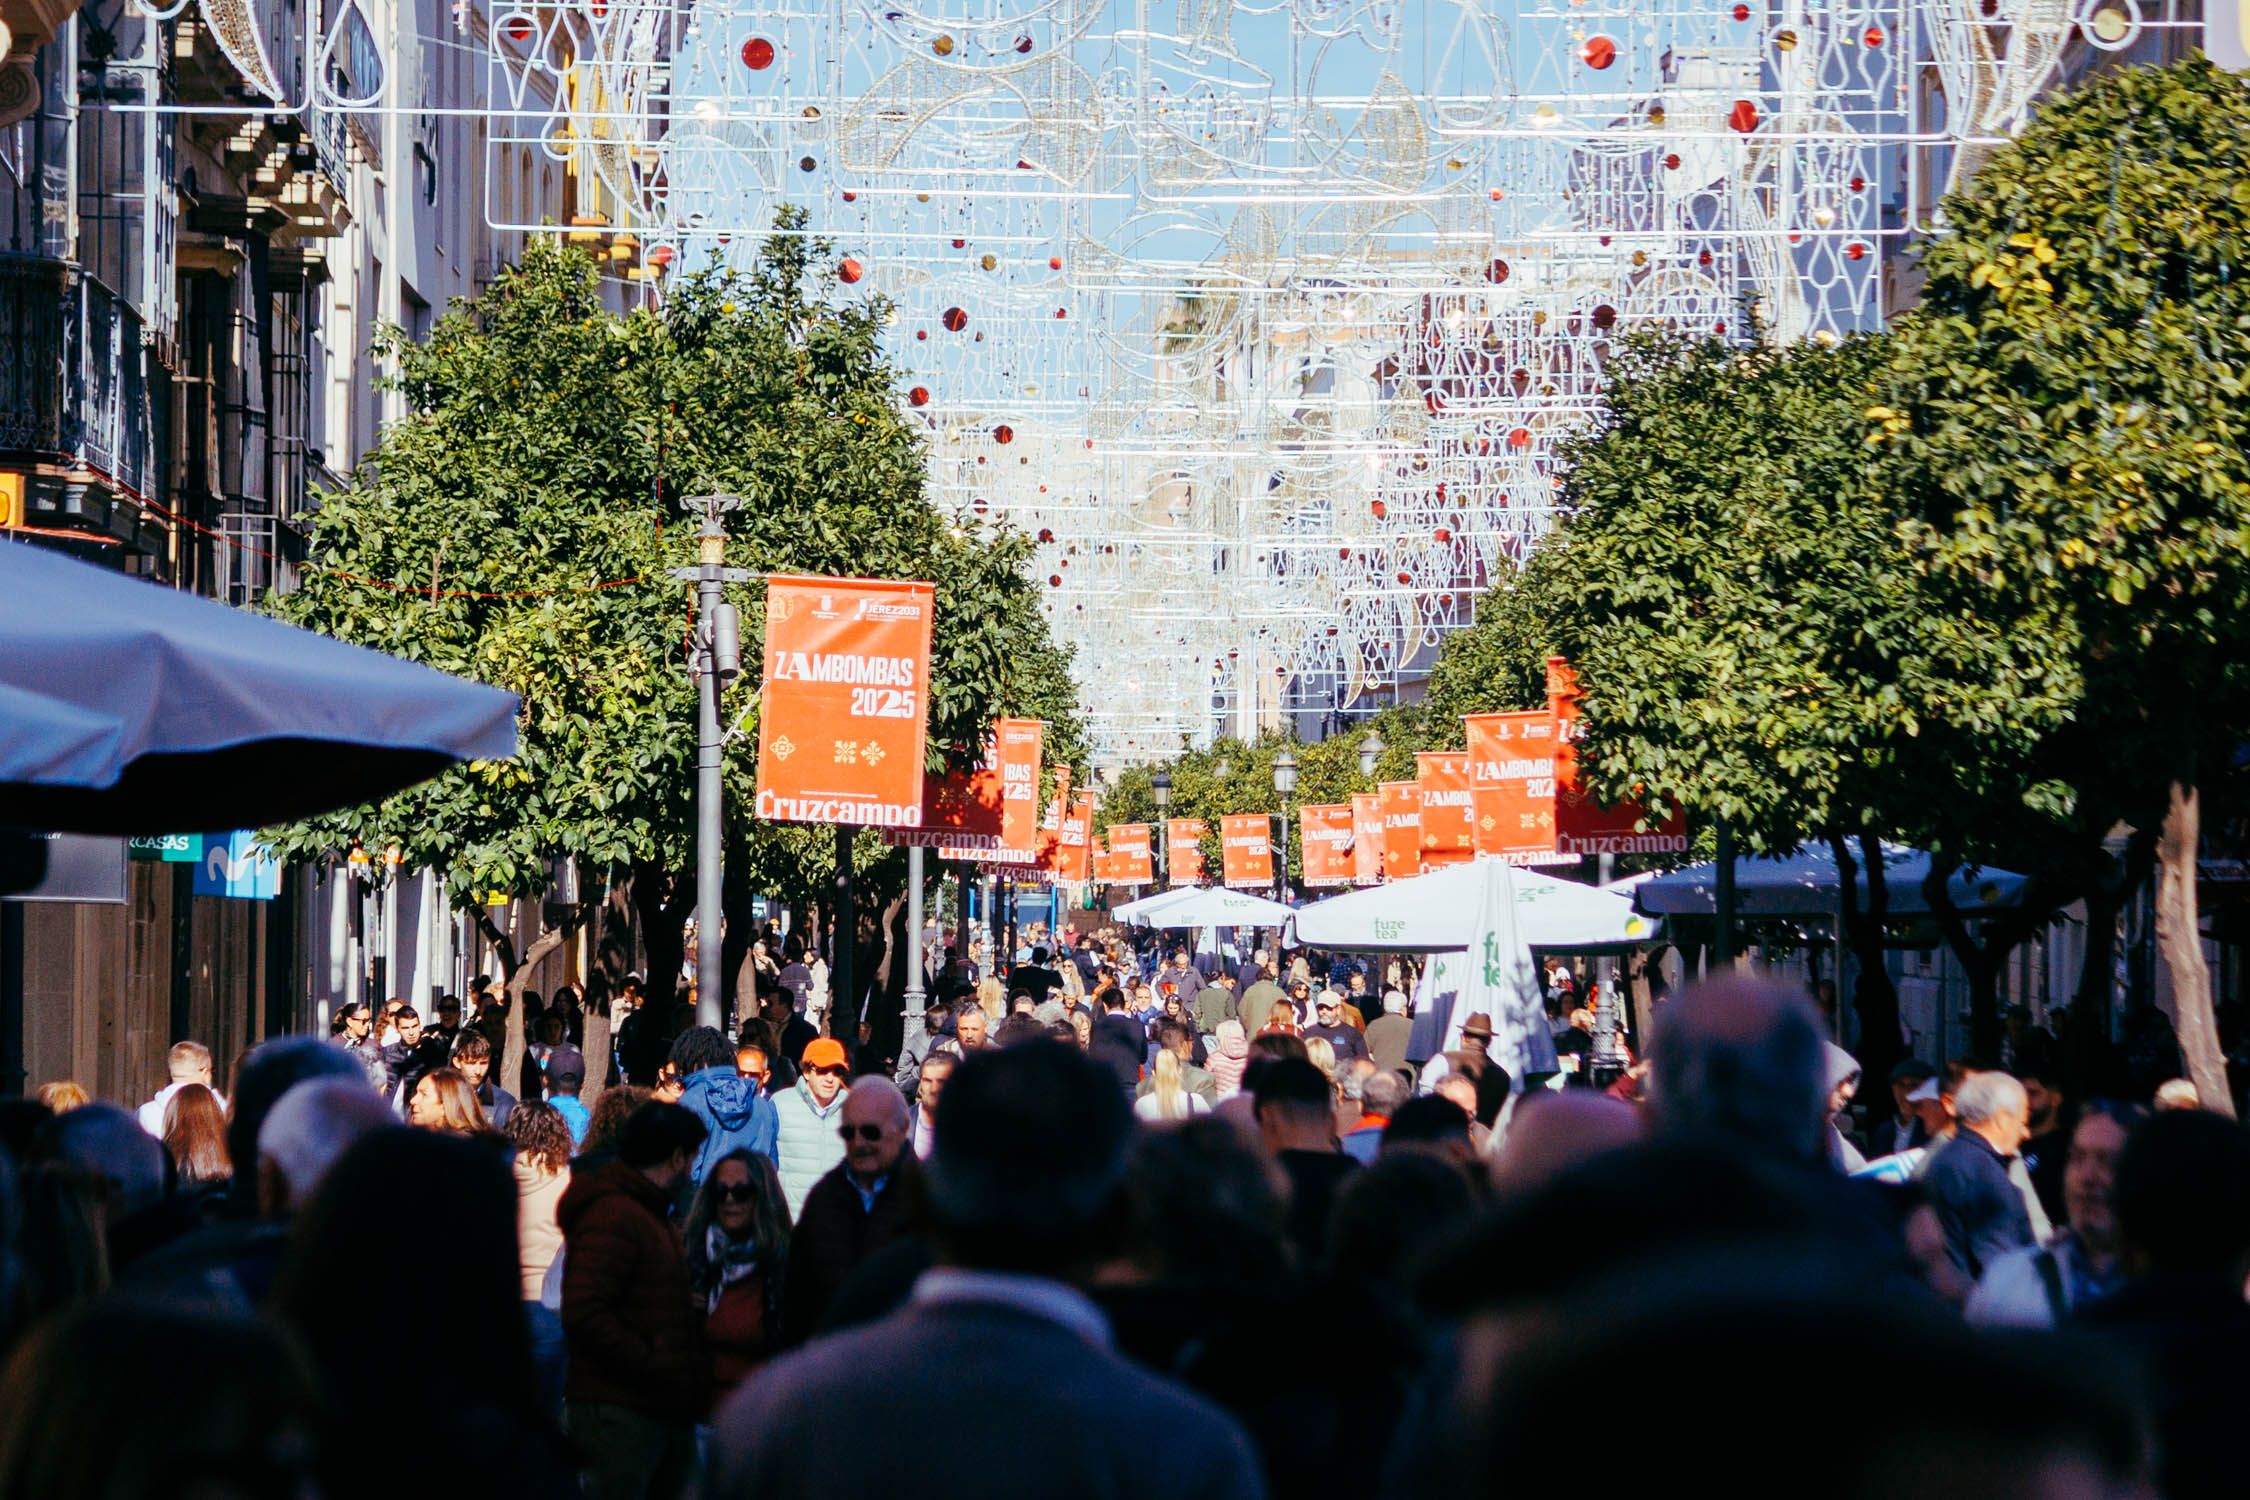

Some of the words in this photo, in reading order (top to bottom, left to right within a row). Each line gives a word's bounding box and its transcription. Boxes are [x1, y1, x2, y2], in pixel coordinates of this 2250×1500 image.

[773, 651, 915, 687] ZAMBOMBAS
[850, 687, 916, 719] 2025
[755, 788, 923, 828] Cruzcampo
[1374, 917, 1406, 930] fuze
[1375, 929, 1398, 940] tea
